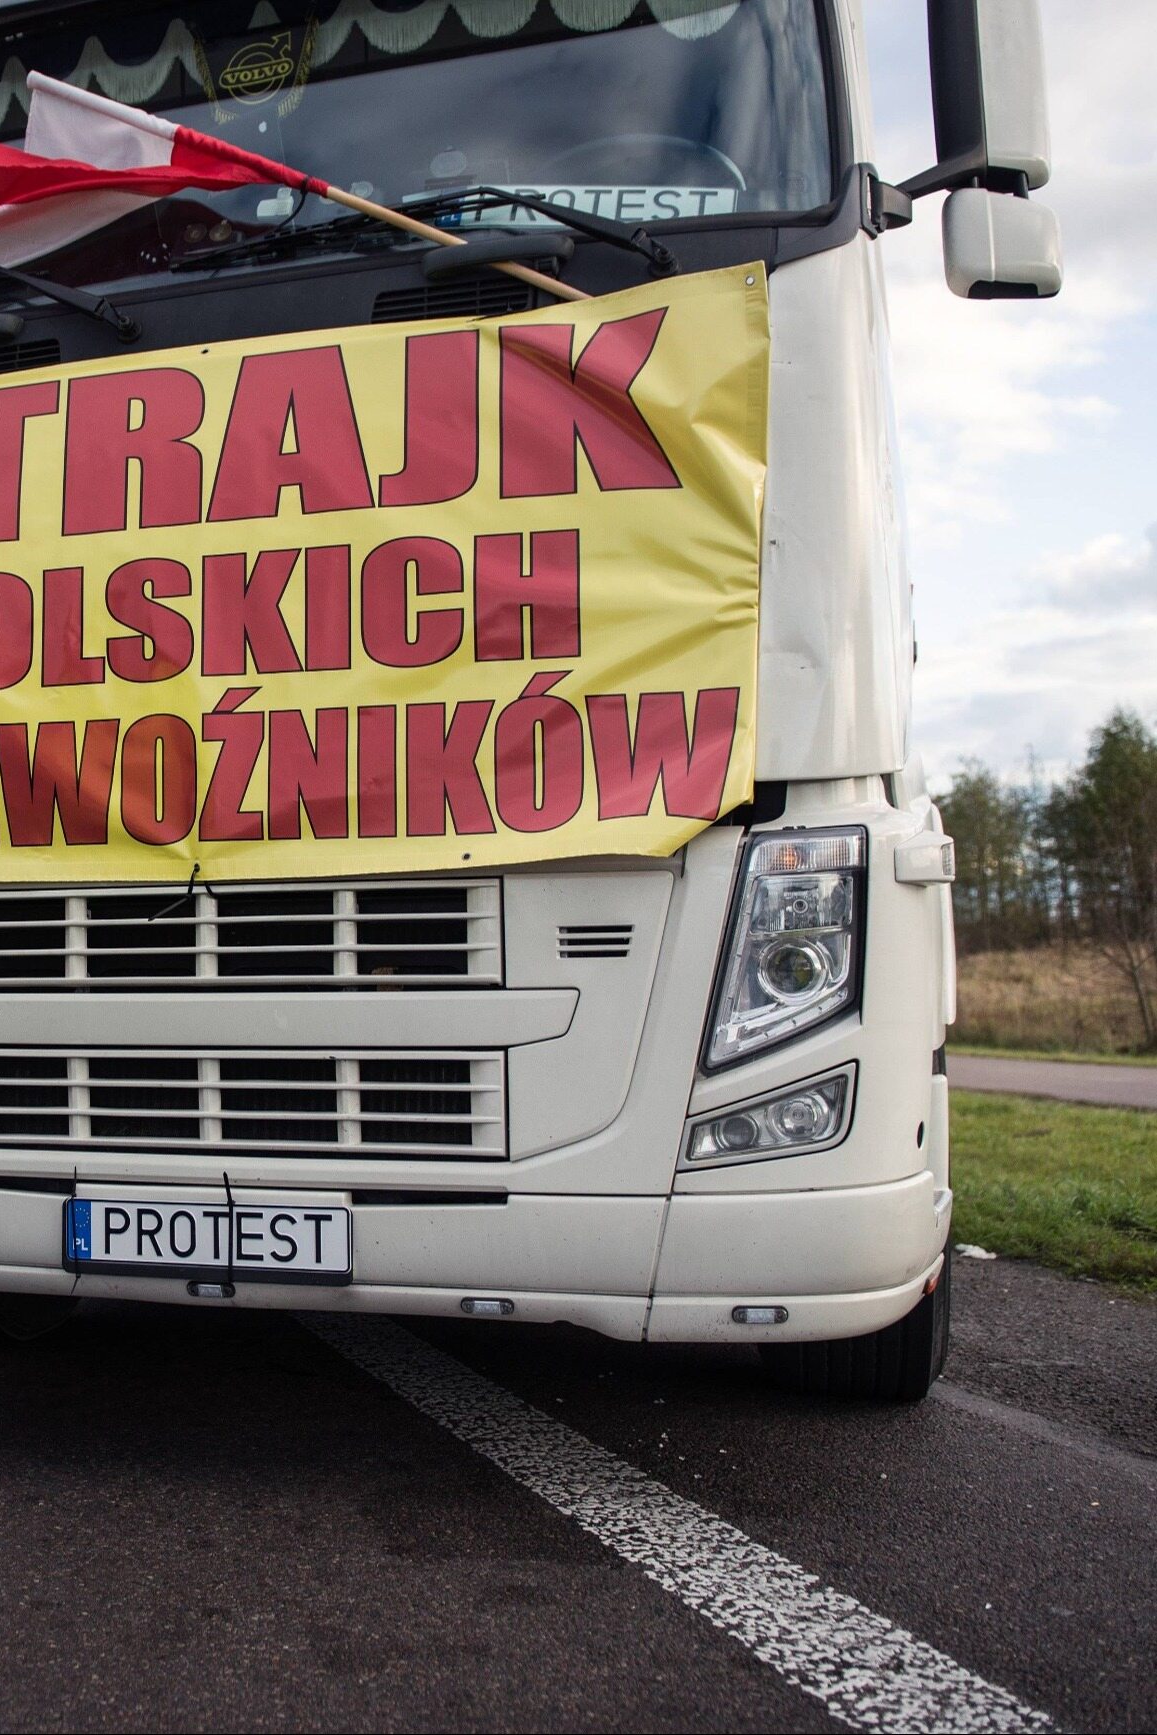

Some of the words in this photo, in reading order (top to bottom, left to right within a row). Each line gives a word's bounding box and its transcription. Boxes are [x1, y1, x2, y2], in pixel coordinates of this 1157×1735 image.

[224, 62, 290, 84] VOLVO
[73, 1237, 89, 1251] PL
[104, 1206, 333, 1264] PROTEST
